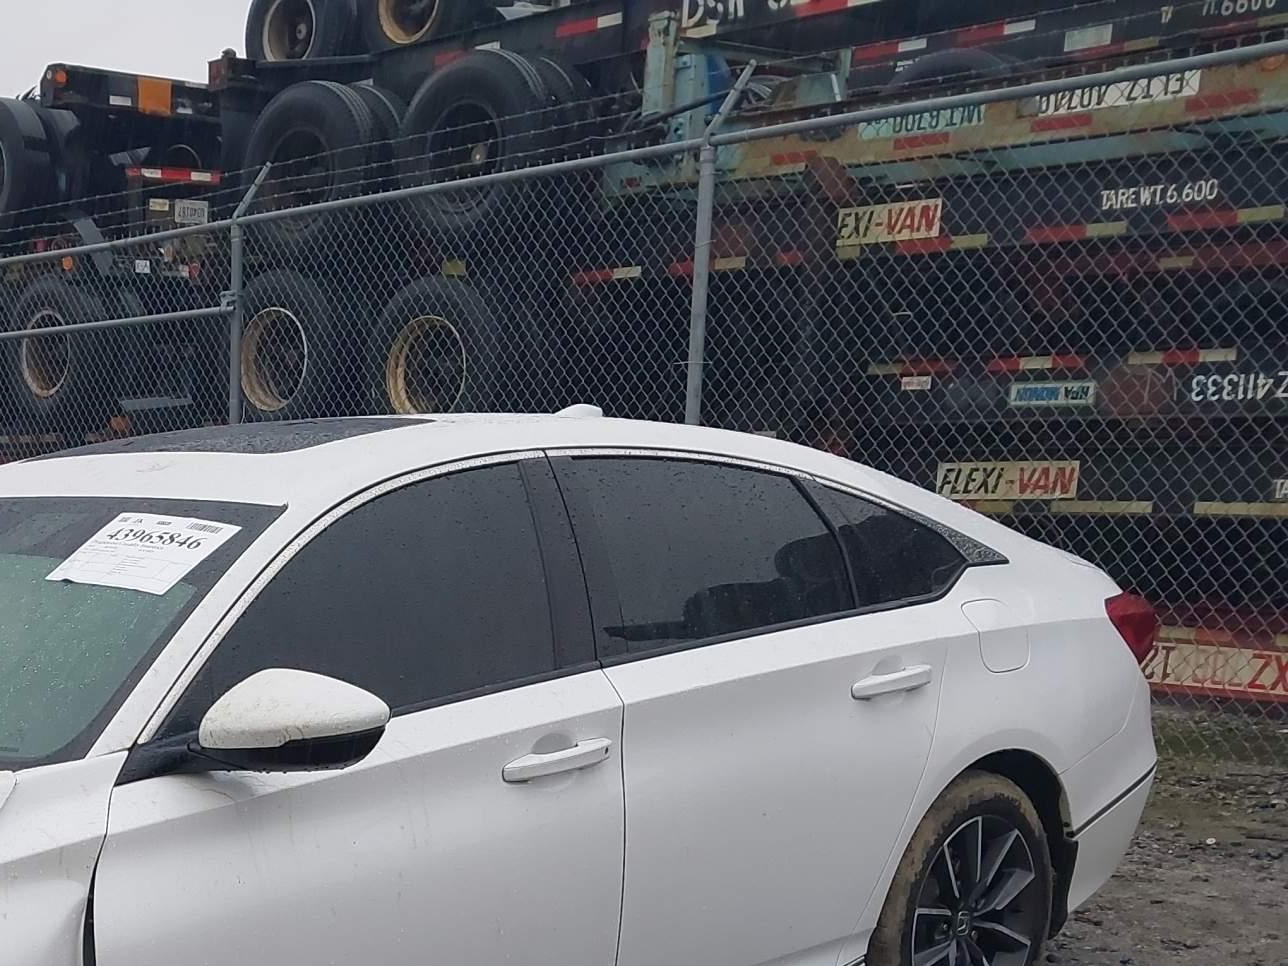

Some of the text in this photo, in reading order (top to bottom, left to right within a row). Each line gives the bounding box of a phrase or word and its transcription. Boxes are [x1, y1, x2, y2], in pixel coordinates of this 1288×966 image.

[1101, 187, 1138, 210] TARE
[1166, 178, 1219, 204] 6.600
[107, 527, 208, 550] 43965846
